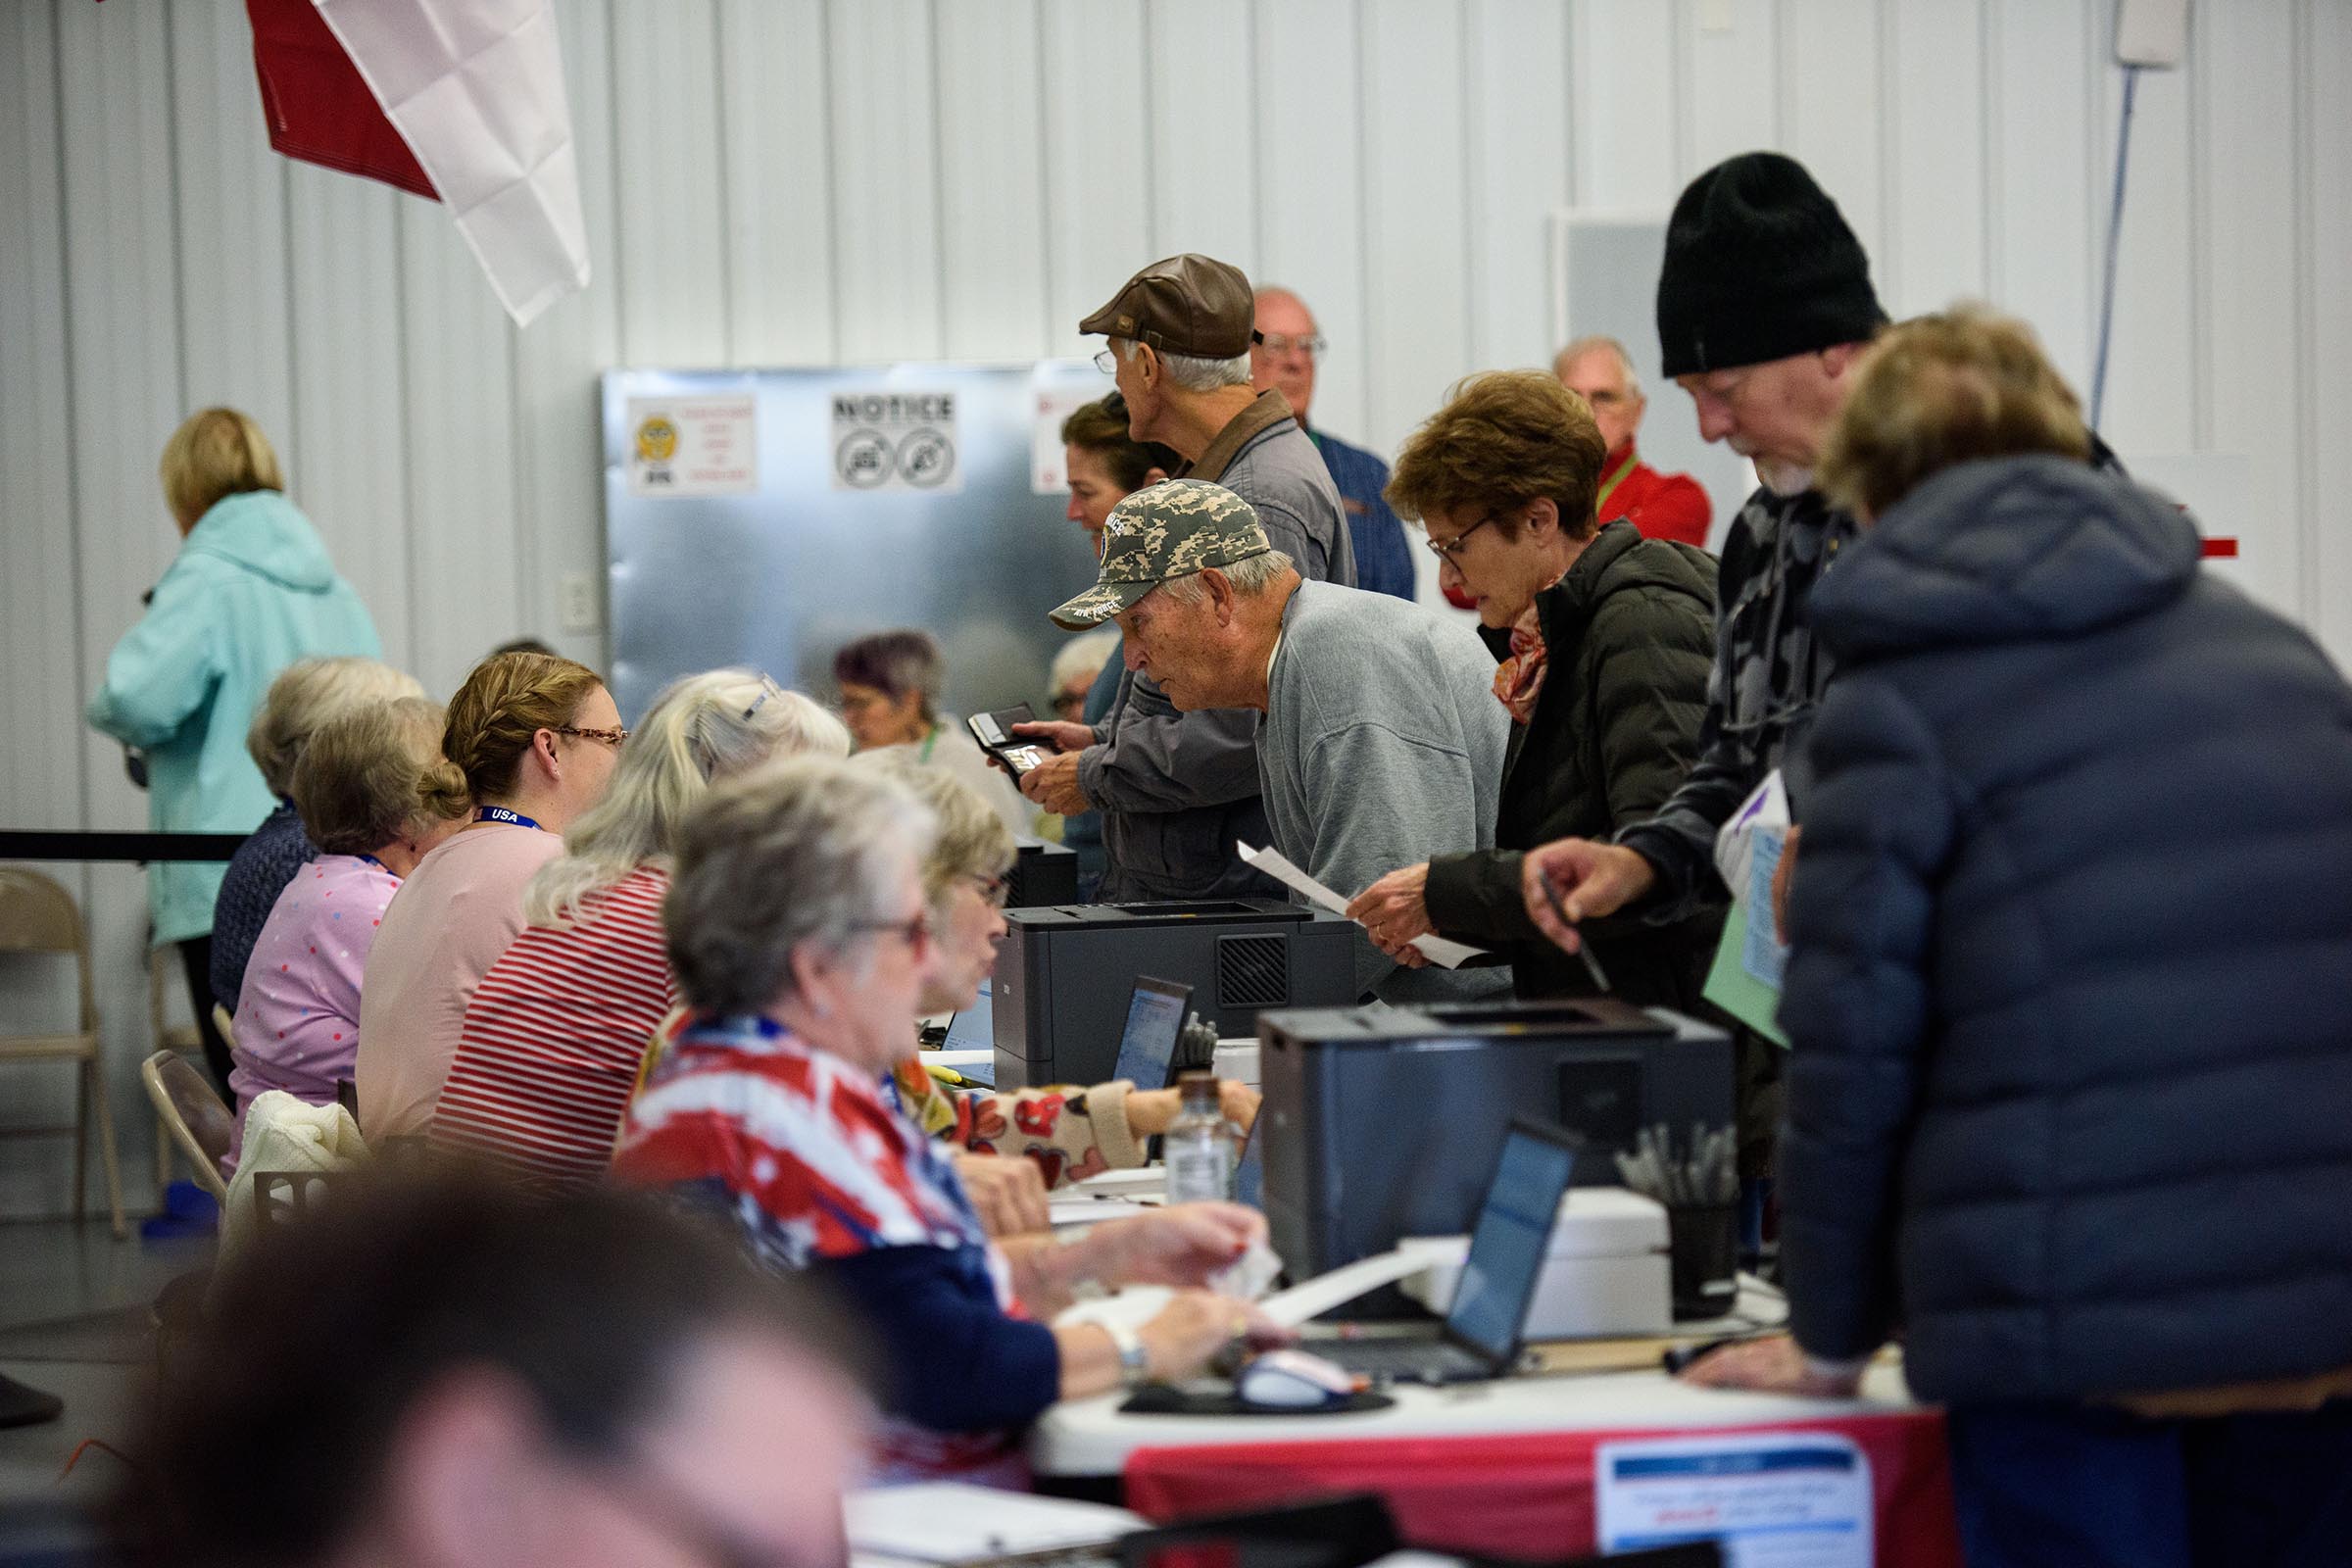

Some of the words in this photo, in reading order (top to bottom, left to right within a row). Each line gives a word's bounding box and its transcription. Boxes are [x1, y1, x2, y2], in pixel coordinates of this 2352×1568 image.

[834, 395, 955, 421] NOTICE
[1073, 609, 1089, 617] AIR
[492, 808, 517, 822] USA
